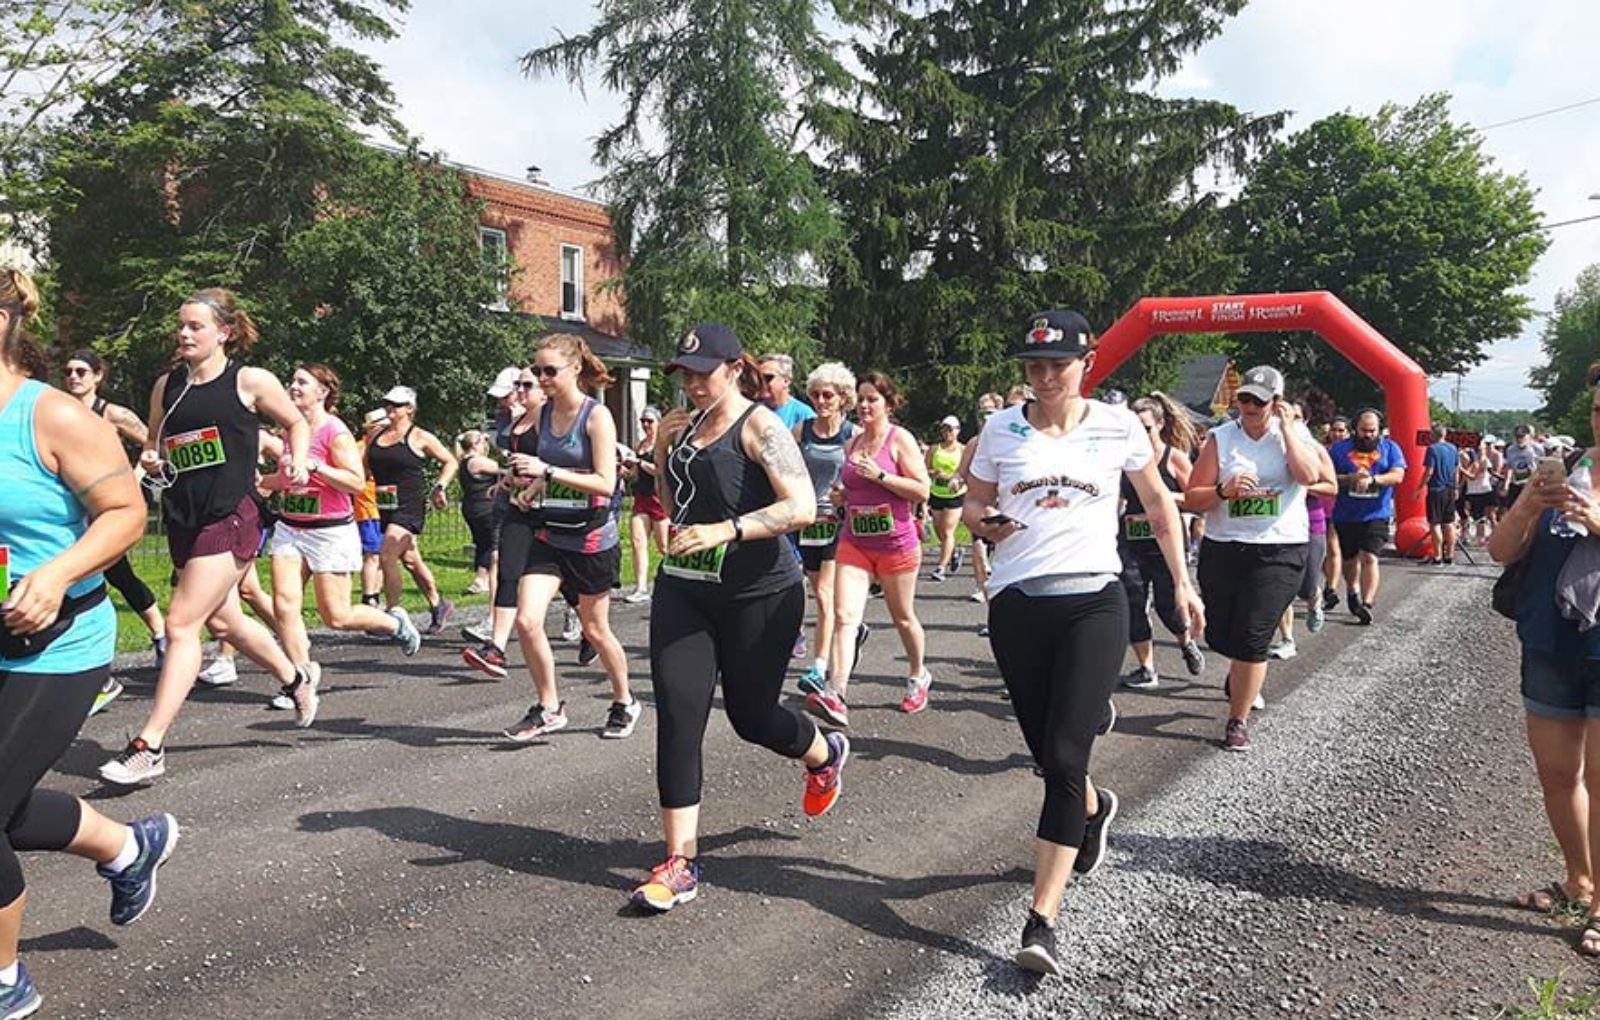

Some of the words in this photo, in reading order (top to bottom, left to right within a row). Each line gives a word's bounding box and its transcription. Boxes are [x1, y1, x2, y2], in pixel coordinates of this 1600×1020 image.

[1212, 302, 1245, 311] START
[170, 440, 218, 470] 4089
[1230, 498, 1274, 517] 4221
